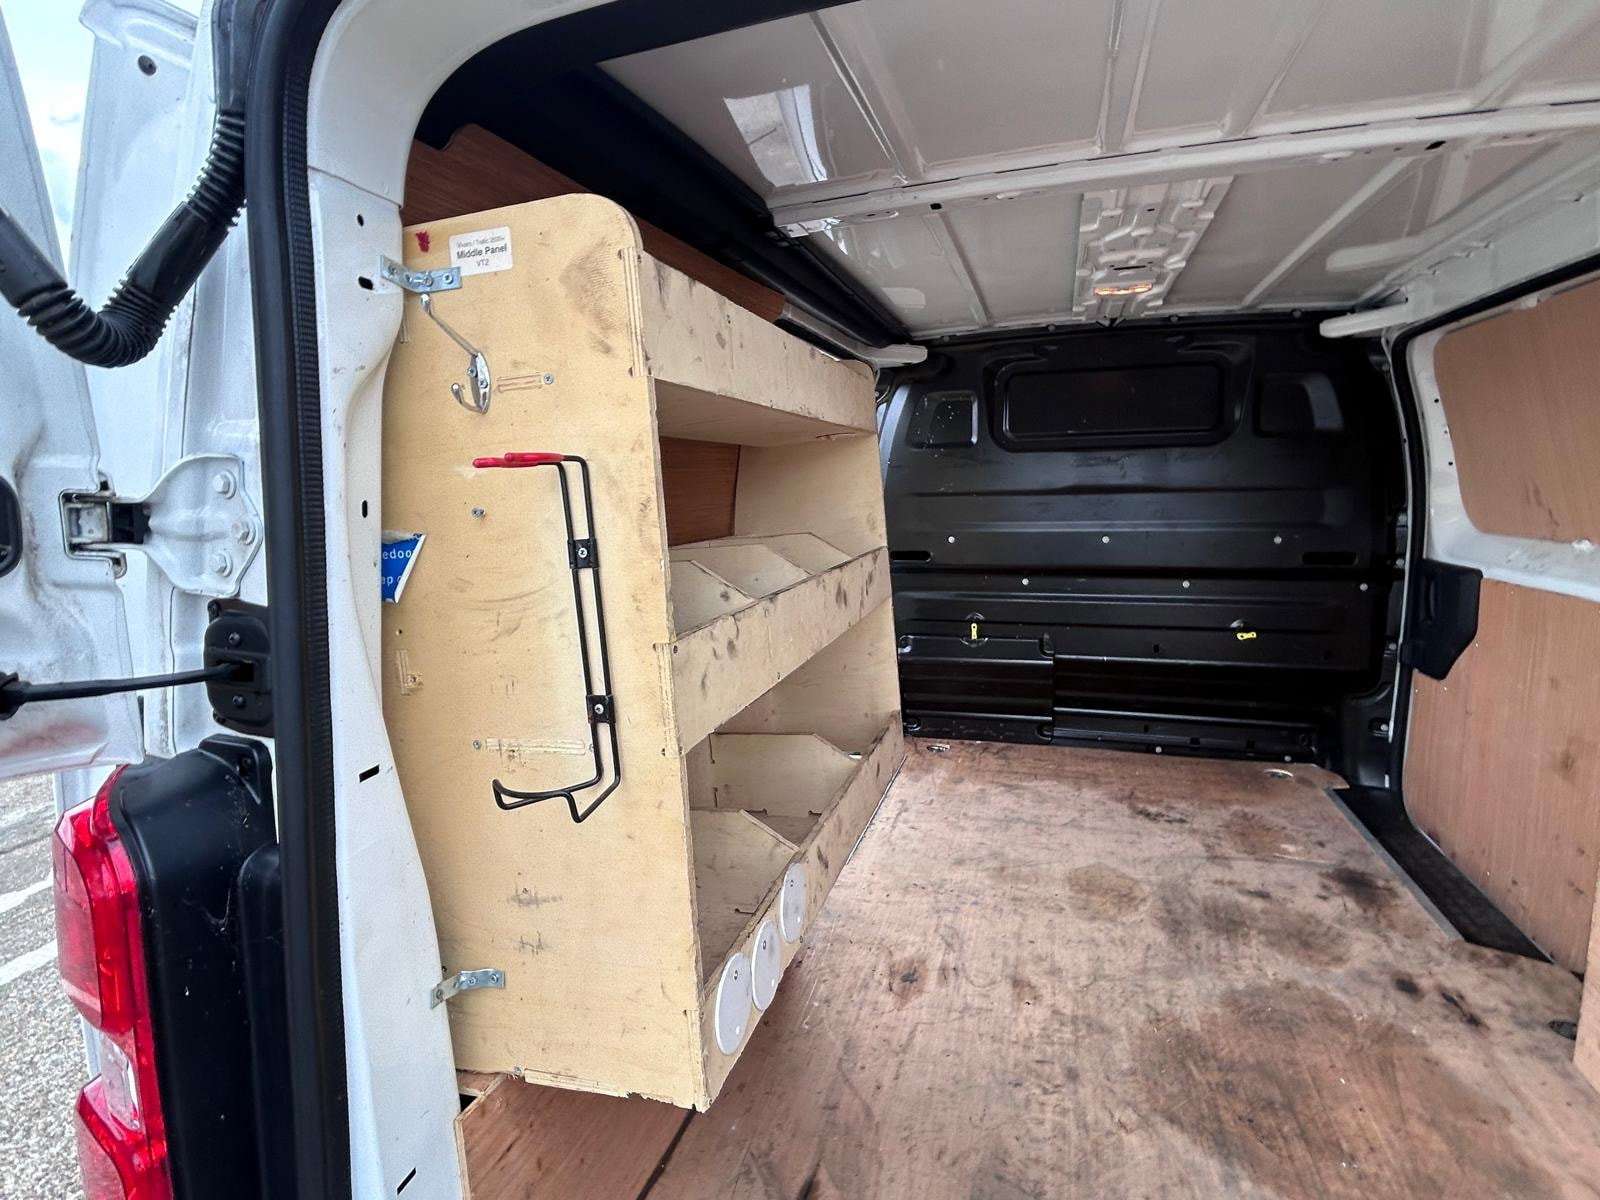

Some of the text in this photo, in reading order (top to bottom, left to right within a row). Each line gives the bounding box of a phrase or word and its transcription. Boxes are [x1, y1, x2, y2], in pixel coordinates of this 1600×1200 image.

[456, 243, 507, 259] Middle Panel
[476, 258, 490, 267] VT2
